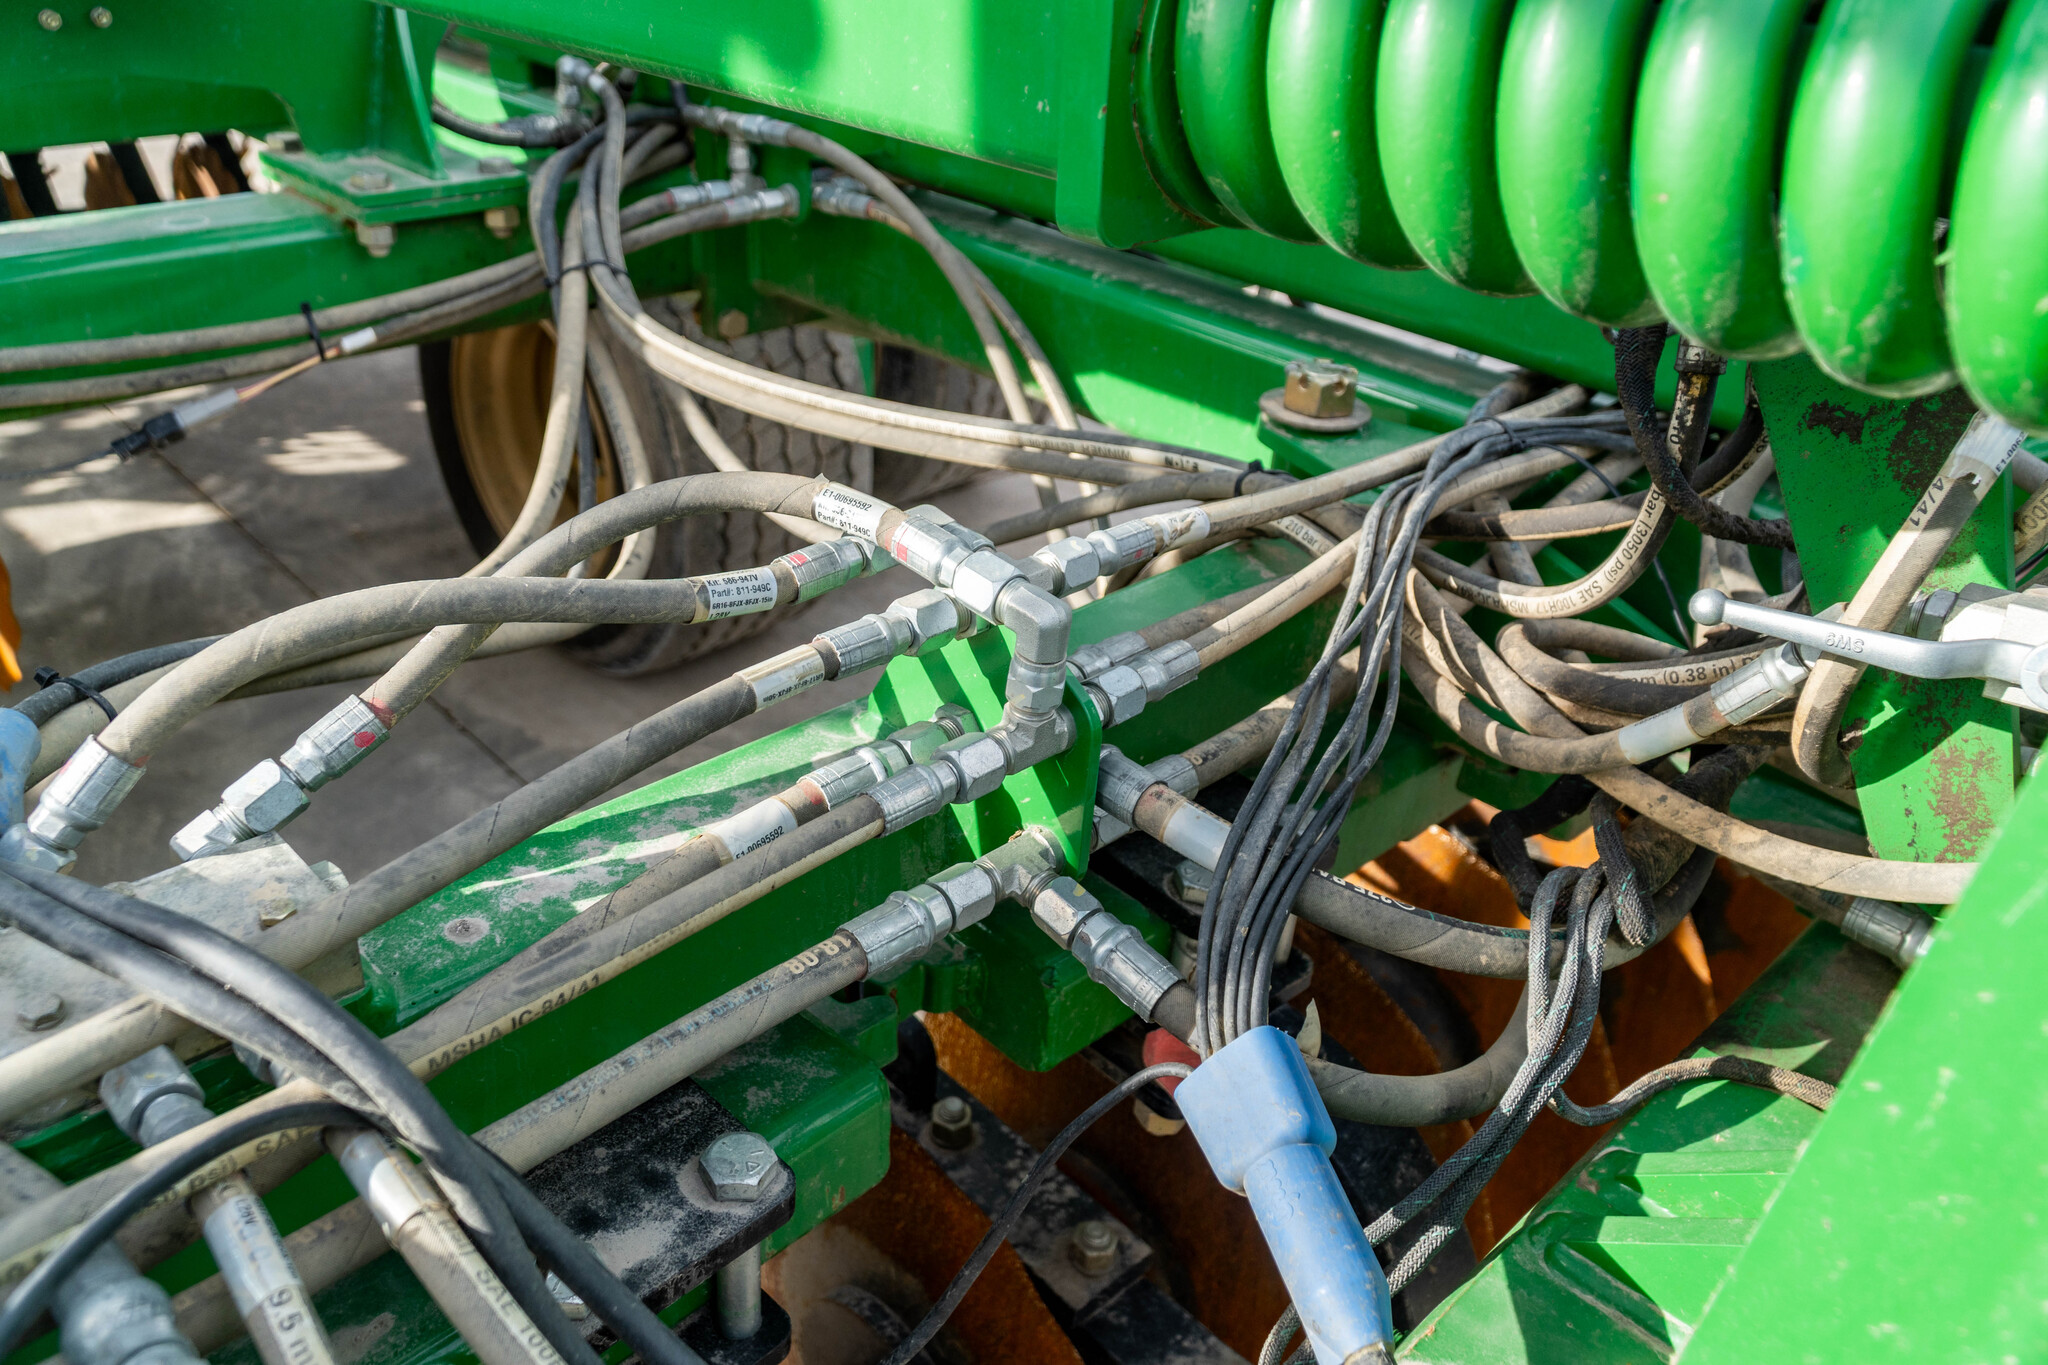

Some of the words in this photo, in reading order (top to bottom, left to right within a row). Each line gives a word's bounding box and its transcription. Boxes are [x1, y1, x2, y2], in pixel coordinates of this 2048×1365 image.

[822, 488, 873, 512] E1-00695592
[839, 519, 871, 537] 811-949C
[1285, 519, 1302, 535] 210
[1301, 531, 1319, 547] bar
[1623, 521, 1653, 560] (3050
[706, 579, 722, 587] Kit:
[1604, 559, 1624, 584] psi)
[711, 588, 735, 598] Part#:
[736, 583, 772, 595] 811-949C
[1581, 580, 1603, 604] SAE
[1535, 596, 1577, 615] 100R17
[1663, 667, 1707, 686] (0.38
[428, 1026, 502, 1073] MSHA
[510, 972, 601, 1031] IC-84/41
[268, 1288, 305, 1331] 9.5
